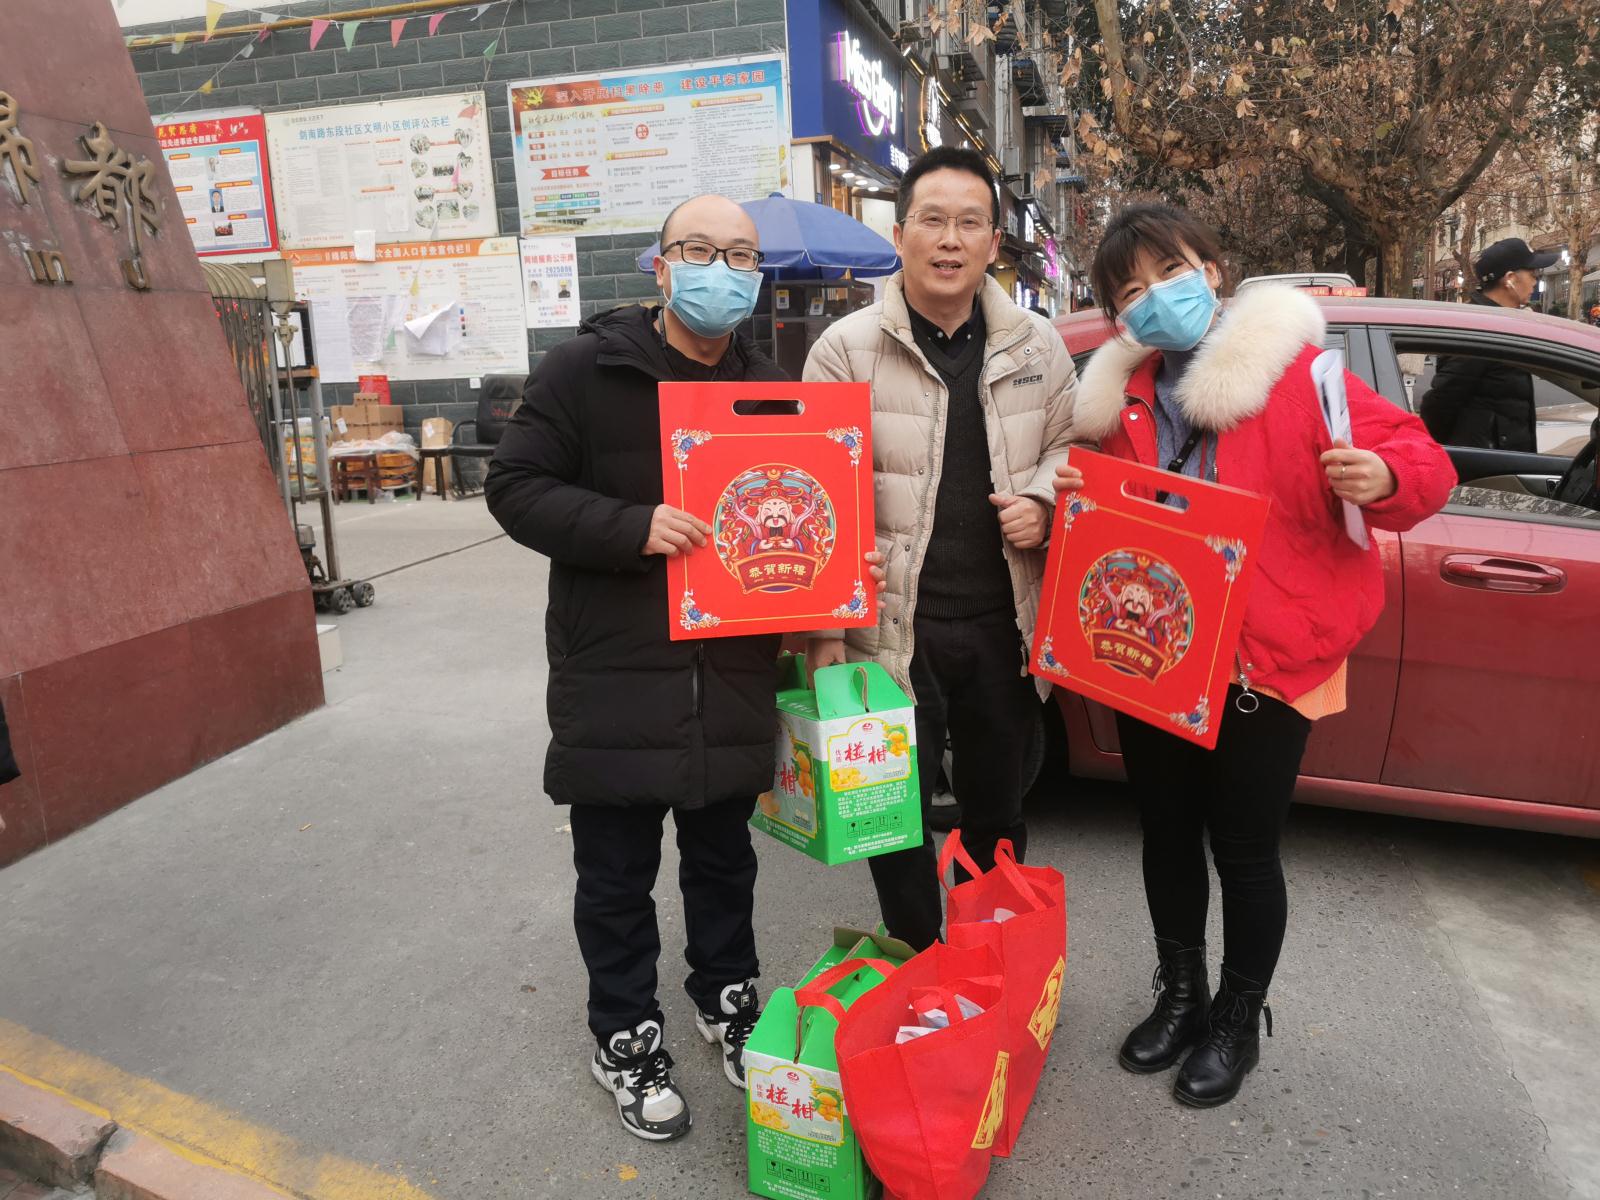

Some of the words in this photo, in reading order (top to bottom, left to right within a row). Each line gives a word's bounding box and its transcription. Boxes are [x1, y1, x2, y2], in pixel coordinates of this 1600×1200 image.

[680, 70, 766, 91] 建设平安家园
[844, 741, 888, 766] 椪柑
[766, 1083, 817, 1121] 椪柑
